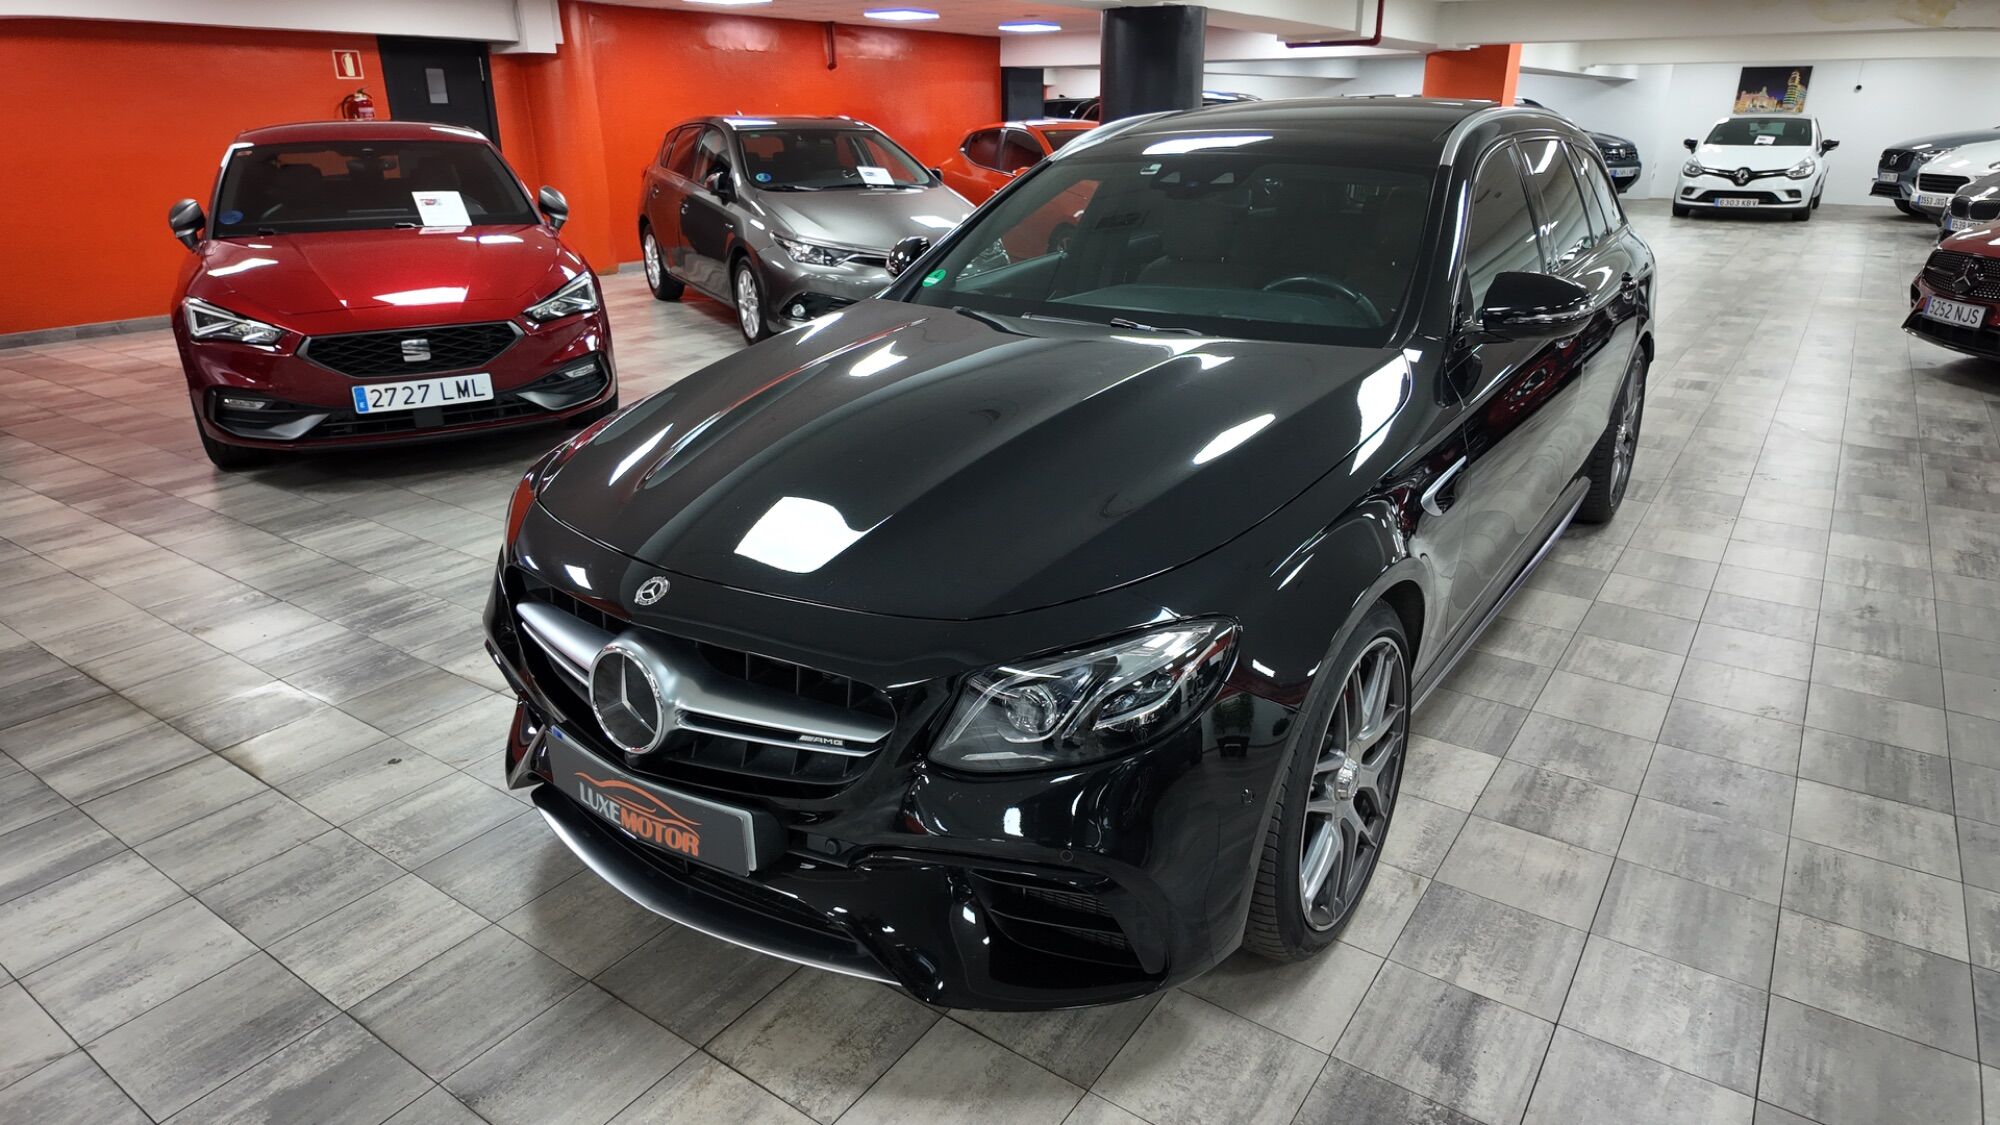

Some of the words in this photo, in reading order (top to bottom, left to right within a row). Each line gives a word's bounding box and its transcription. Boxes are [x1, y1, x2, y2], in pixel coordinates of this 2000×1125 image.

[1929, 299, 1953, 319] 5252
[1954, 305, 1979, 324] NJS
[370, 384, 430, 408] 2727
[440, 379, 485, 401] LML
[813, 737, 843, 746] AMG
